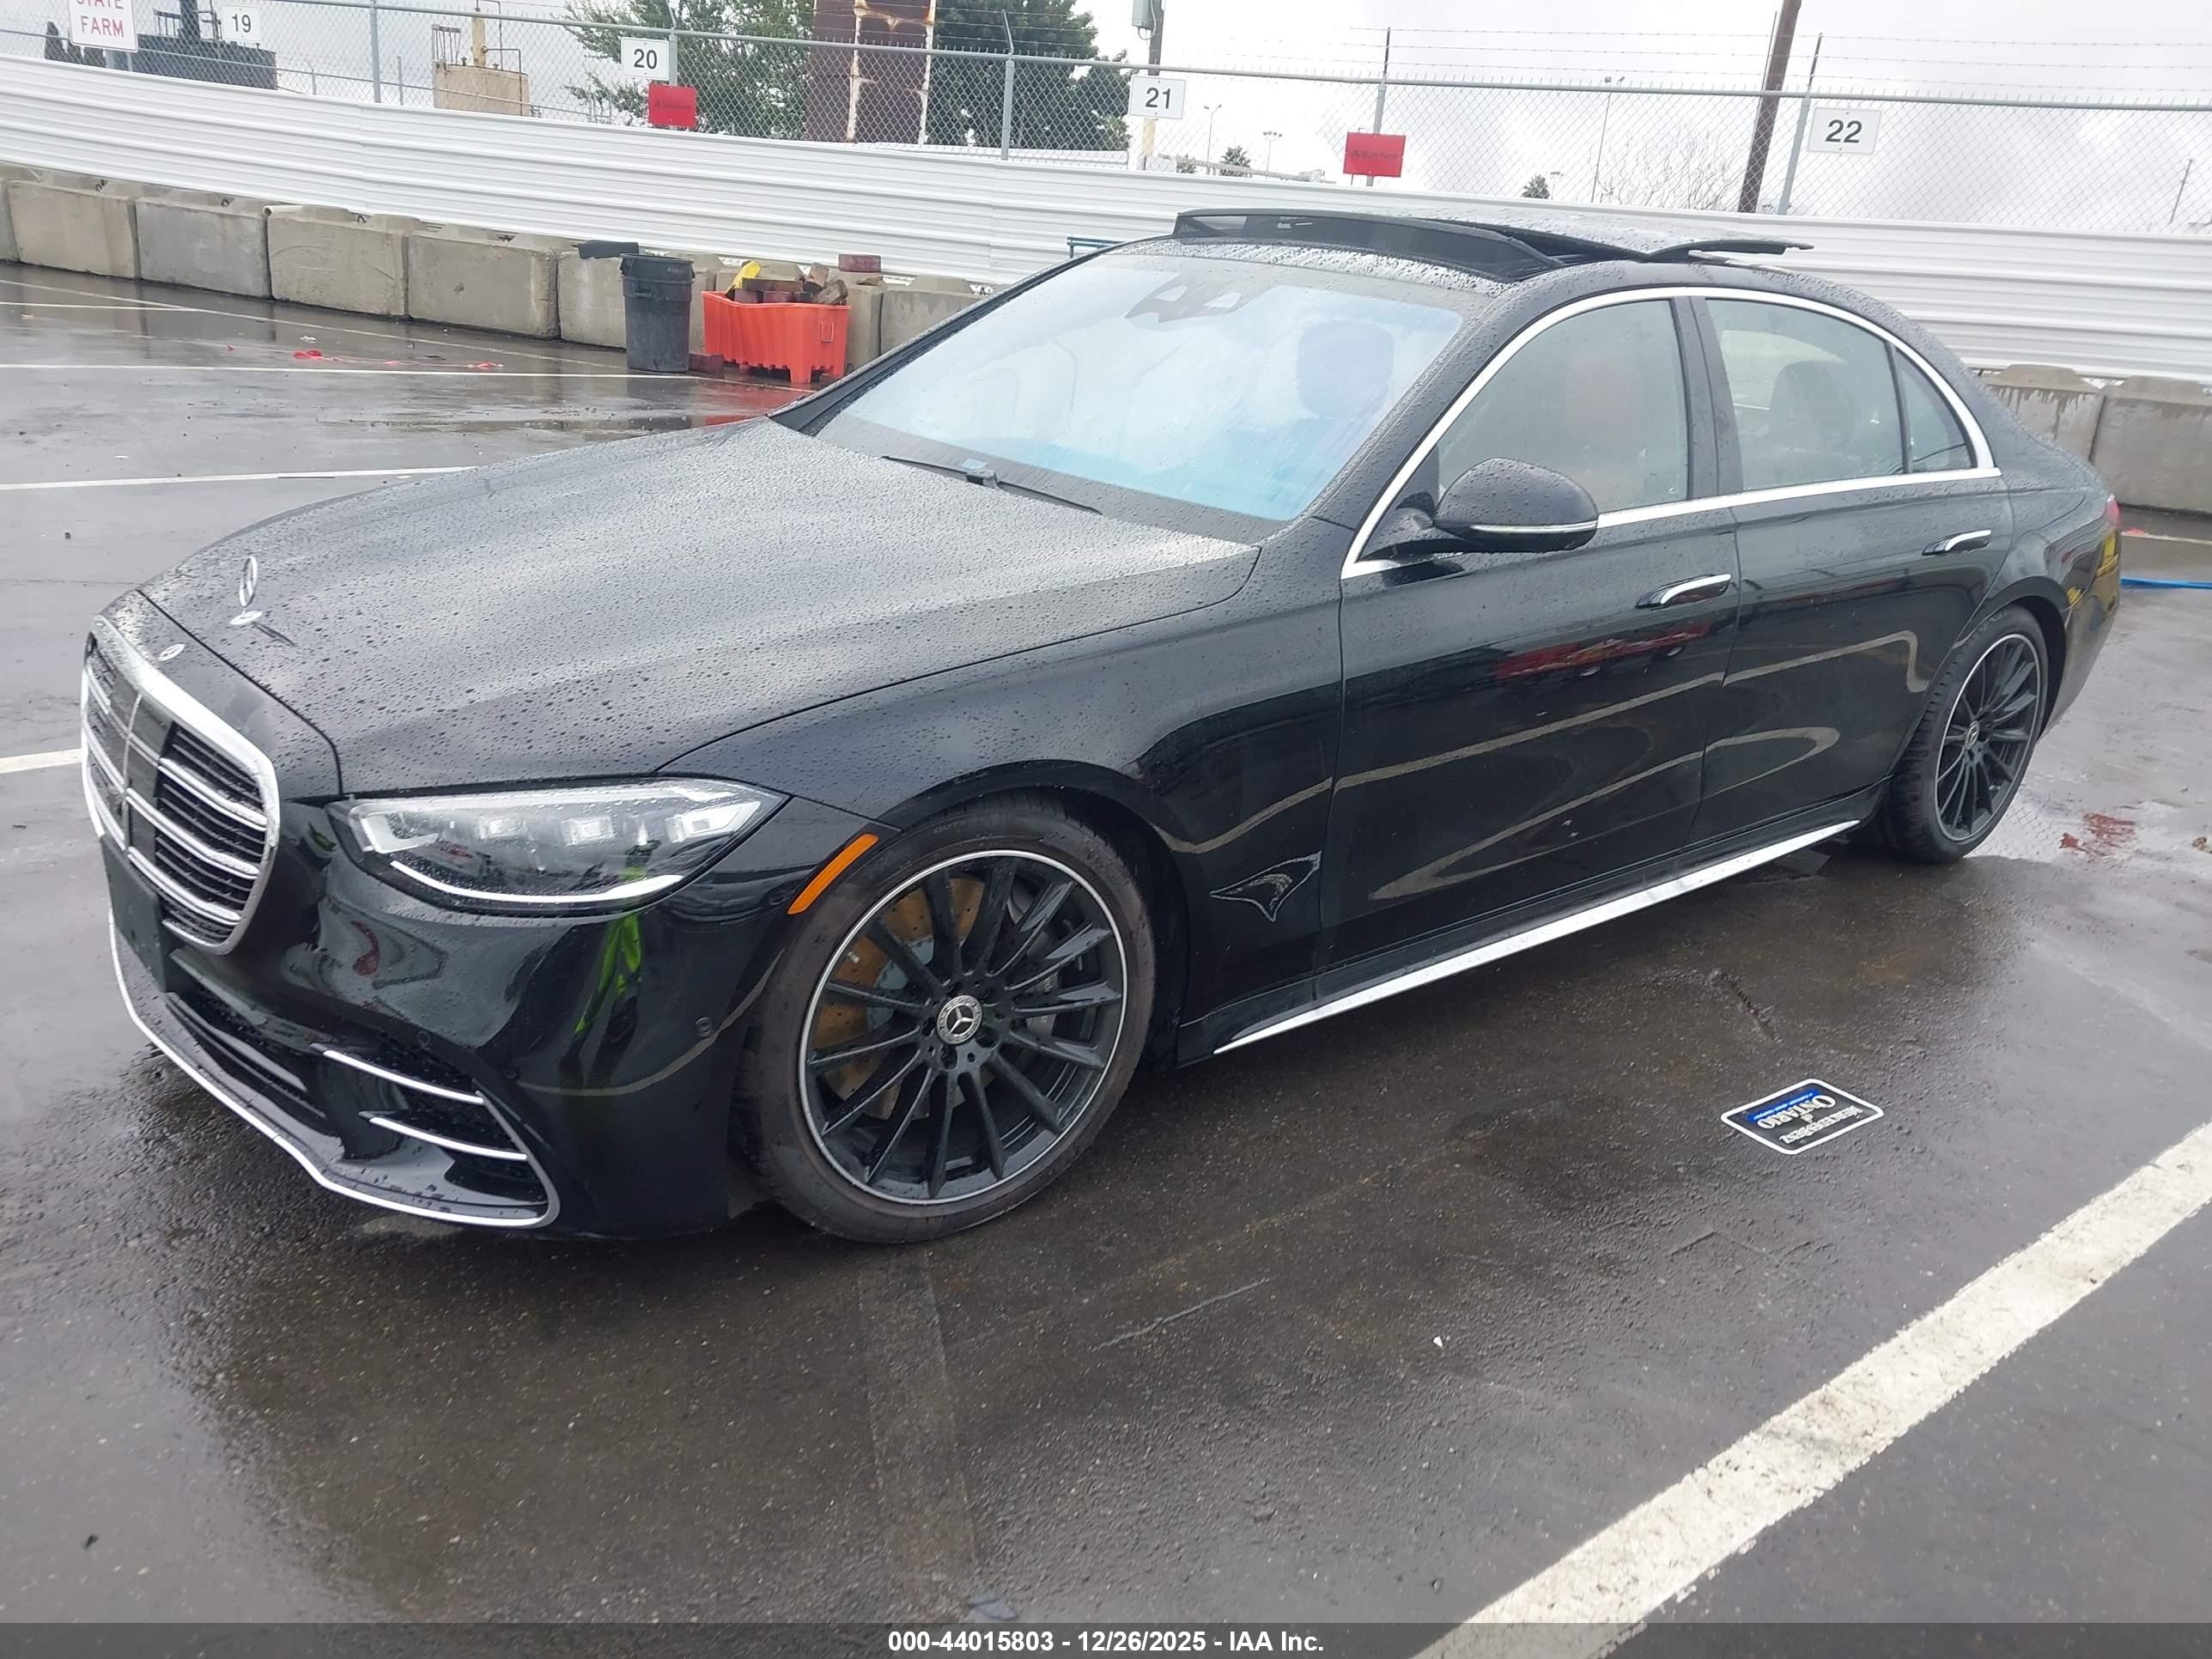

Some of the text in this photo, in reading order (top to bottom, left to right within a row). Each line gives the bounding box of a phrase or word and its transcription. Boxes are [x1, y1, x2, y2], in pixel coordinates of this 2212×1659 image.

[80, 15, 125, 38] FARM
[231, 13, 252, 33] 19
[633, 48, 658, 70] 20
[1145, 87, 1171, 109] 21
[1825, 118, 1863, 143] 22
